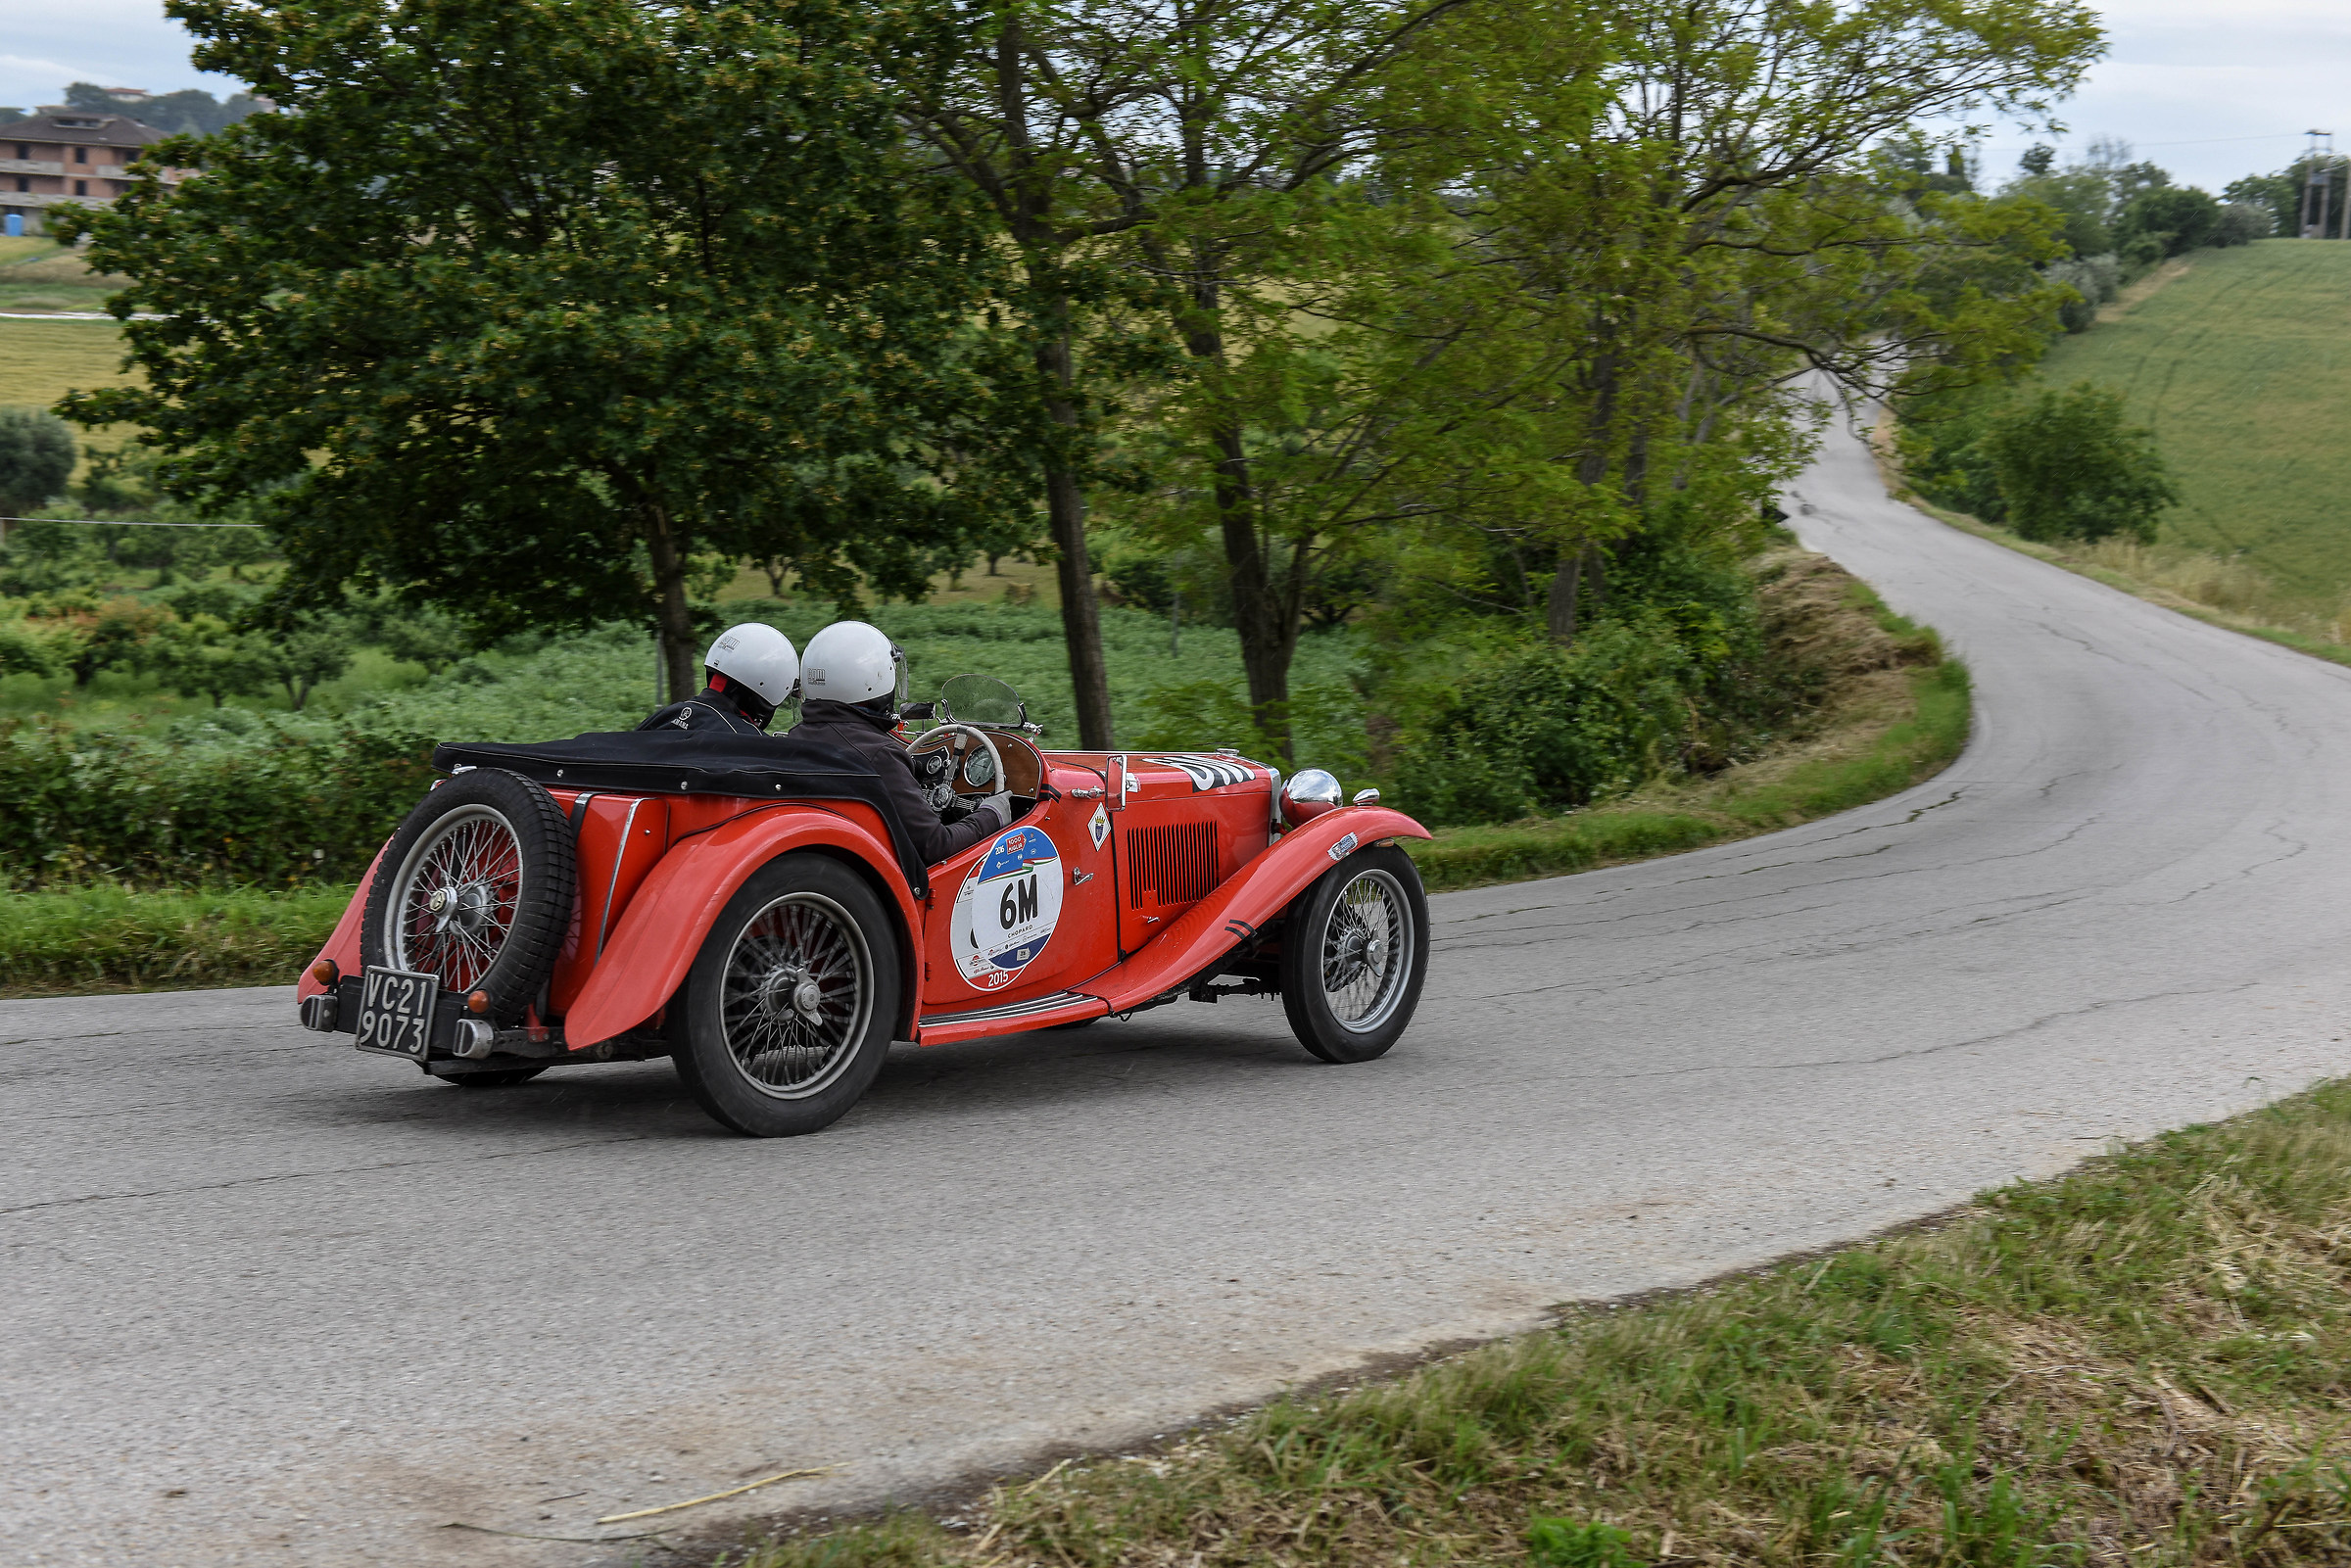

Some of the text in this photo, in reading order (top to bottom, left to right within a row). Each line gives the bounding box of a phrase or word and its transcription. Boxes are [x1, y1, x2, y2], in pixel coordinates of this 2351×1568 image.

[1008, 836, 1022, 845] 1000
[1000, 874, 1038, 929] 6M
[1007, 924, 1033, 938] CHOPARD
[987, 971, 1009, 988] 2015
[359, 1010, 425, 1053] 9073
